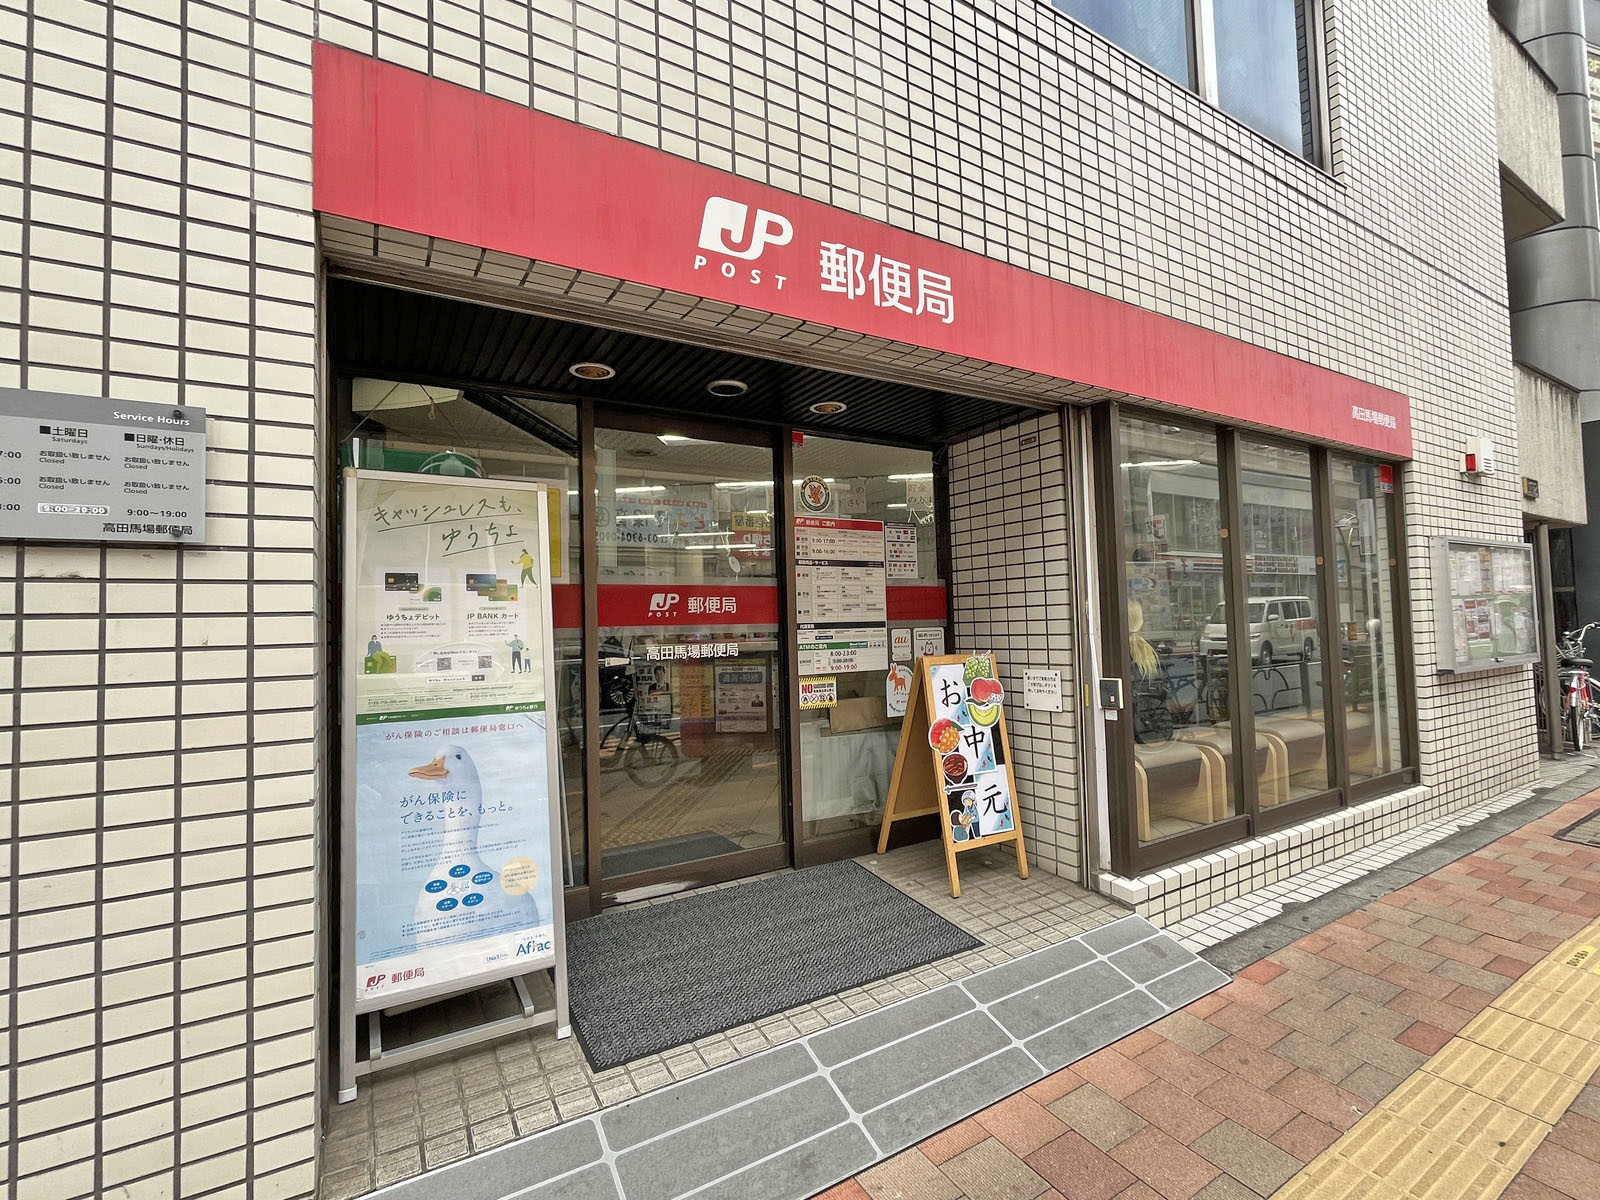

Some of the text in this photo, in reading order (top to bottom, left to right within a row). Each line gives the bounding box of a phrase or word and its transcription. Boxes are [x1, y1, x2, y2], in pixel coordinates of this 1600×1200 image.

[698, 196, 794, 261] JP
[693, 254, 787, 290] POST
[819, 240, 954, 324] 郵便局
[113, 411, 190, 426] Service Hours
[1351, 405, 1396, 430] 高田馬場郵便局
[52, 427, 88, 438] 土曜日
[52, 436, 88, 445] Saturdays
[39, 450, 110, 461] お取扱い致しません
[136, 443, 194, 453] Sundays/Holidays
[124, 456, 190, 467] お取扱い致しません
[373, 495, 522, 525] キャッシュレスも、
[442, 523, 518, 551] ゆうちょ
[649, 593, 680, 611] JP
[687, 596, 737, 615] 郵便局
[386, 613, 440, 621] ゆうちょデビット
[501, 612, 519, 620] カード
[894, 636, 909, 644] au
[646, 643, 739, 662] 高田馬場郵便局
[802, 684, 813, 694] NO
[385, 723, 524, 741] がん保険のご相談は郵便局窓口へ
[400, 790, 467, 808] がん保険に
[400, 801, 514, 825] できることを、もっと。
[391, 967, 425, 984] 郵便局
